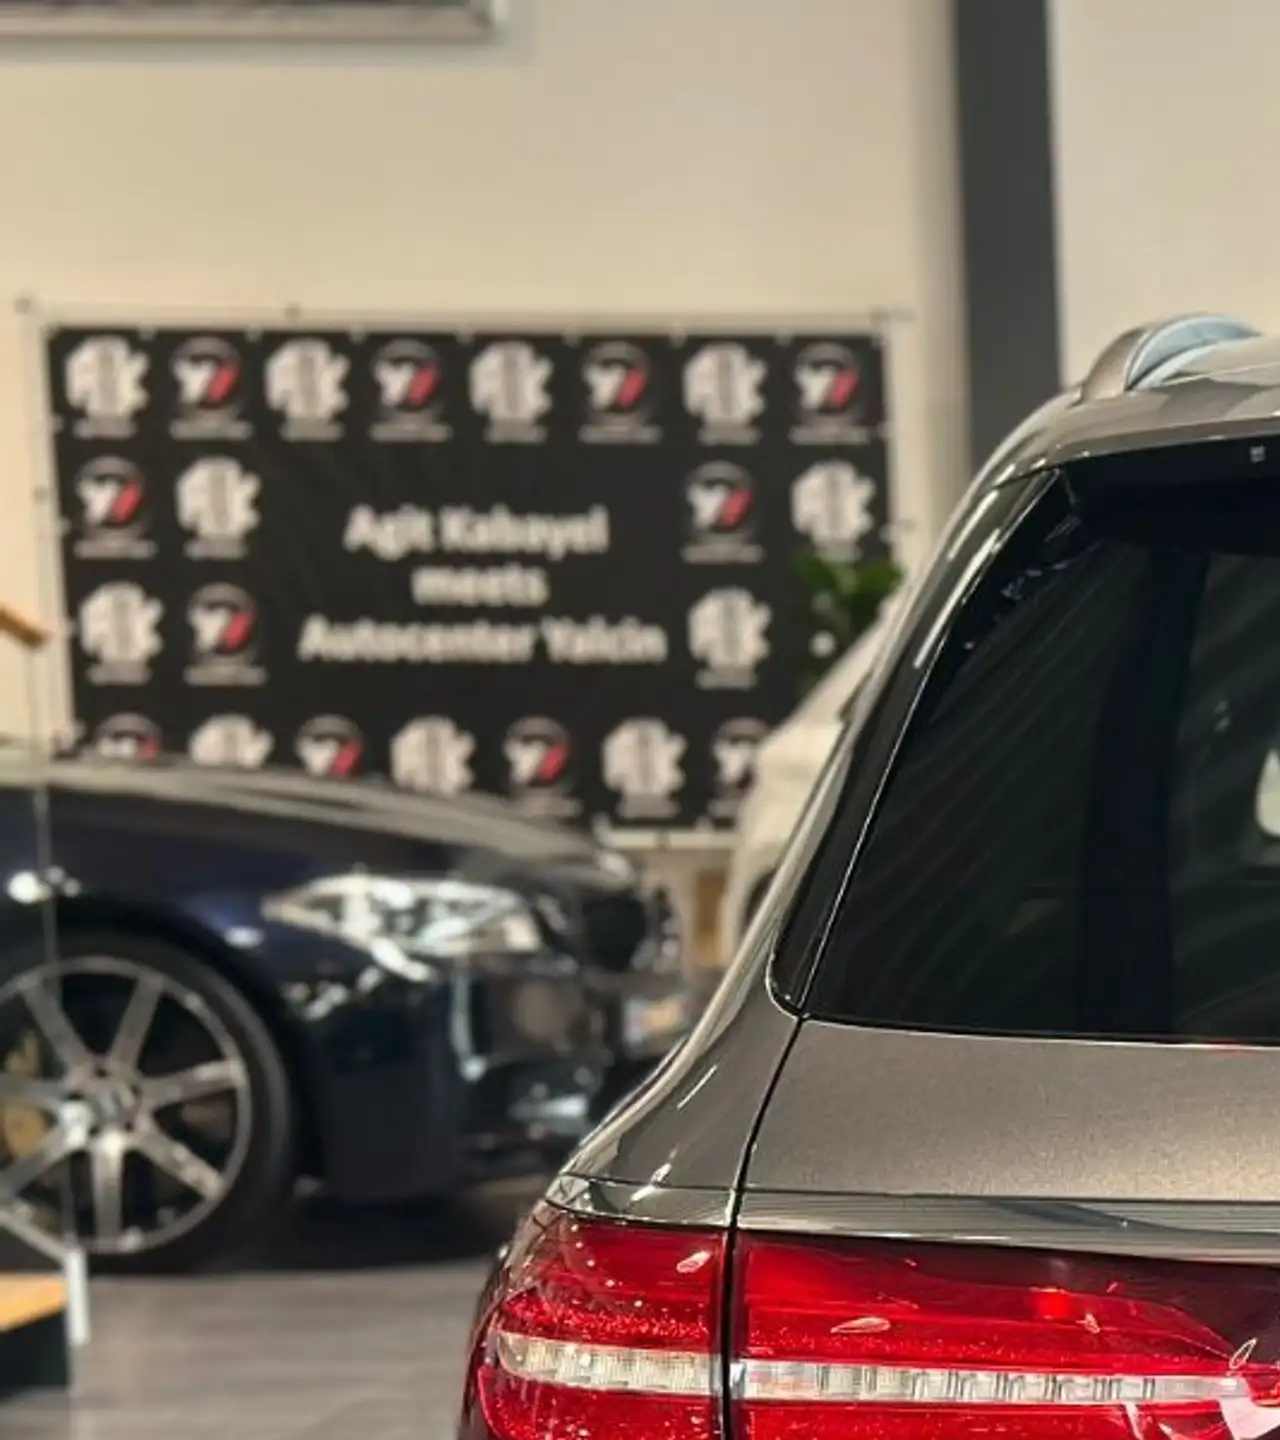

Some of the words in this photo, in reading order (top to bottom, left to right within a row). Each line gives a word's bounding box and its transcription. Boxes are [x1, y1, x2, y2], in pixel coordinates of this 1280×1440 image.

[344, 503, 433, 560] Agit
[411, 565, 548, 606] meets
[298, 614, 536, 661] Autocenter
[541, 615, 667, 663] Yalcin
